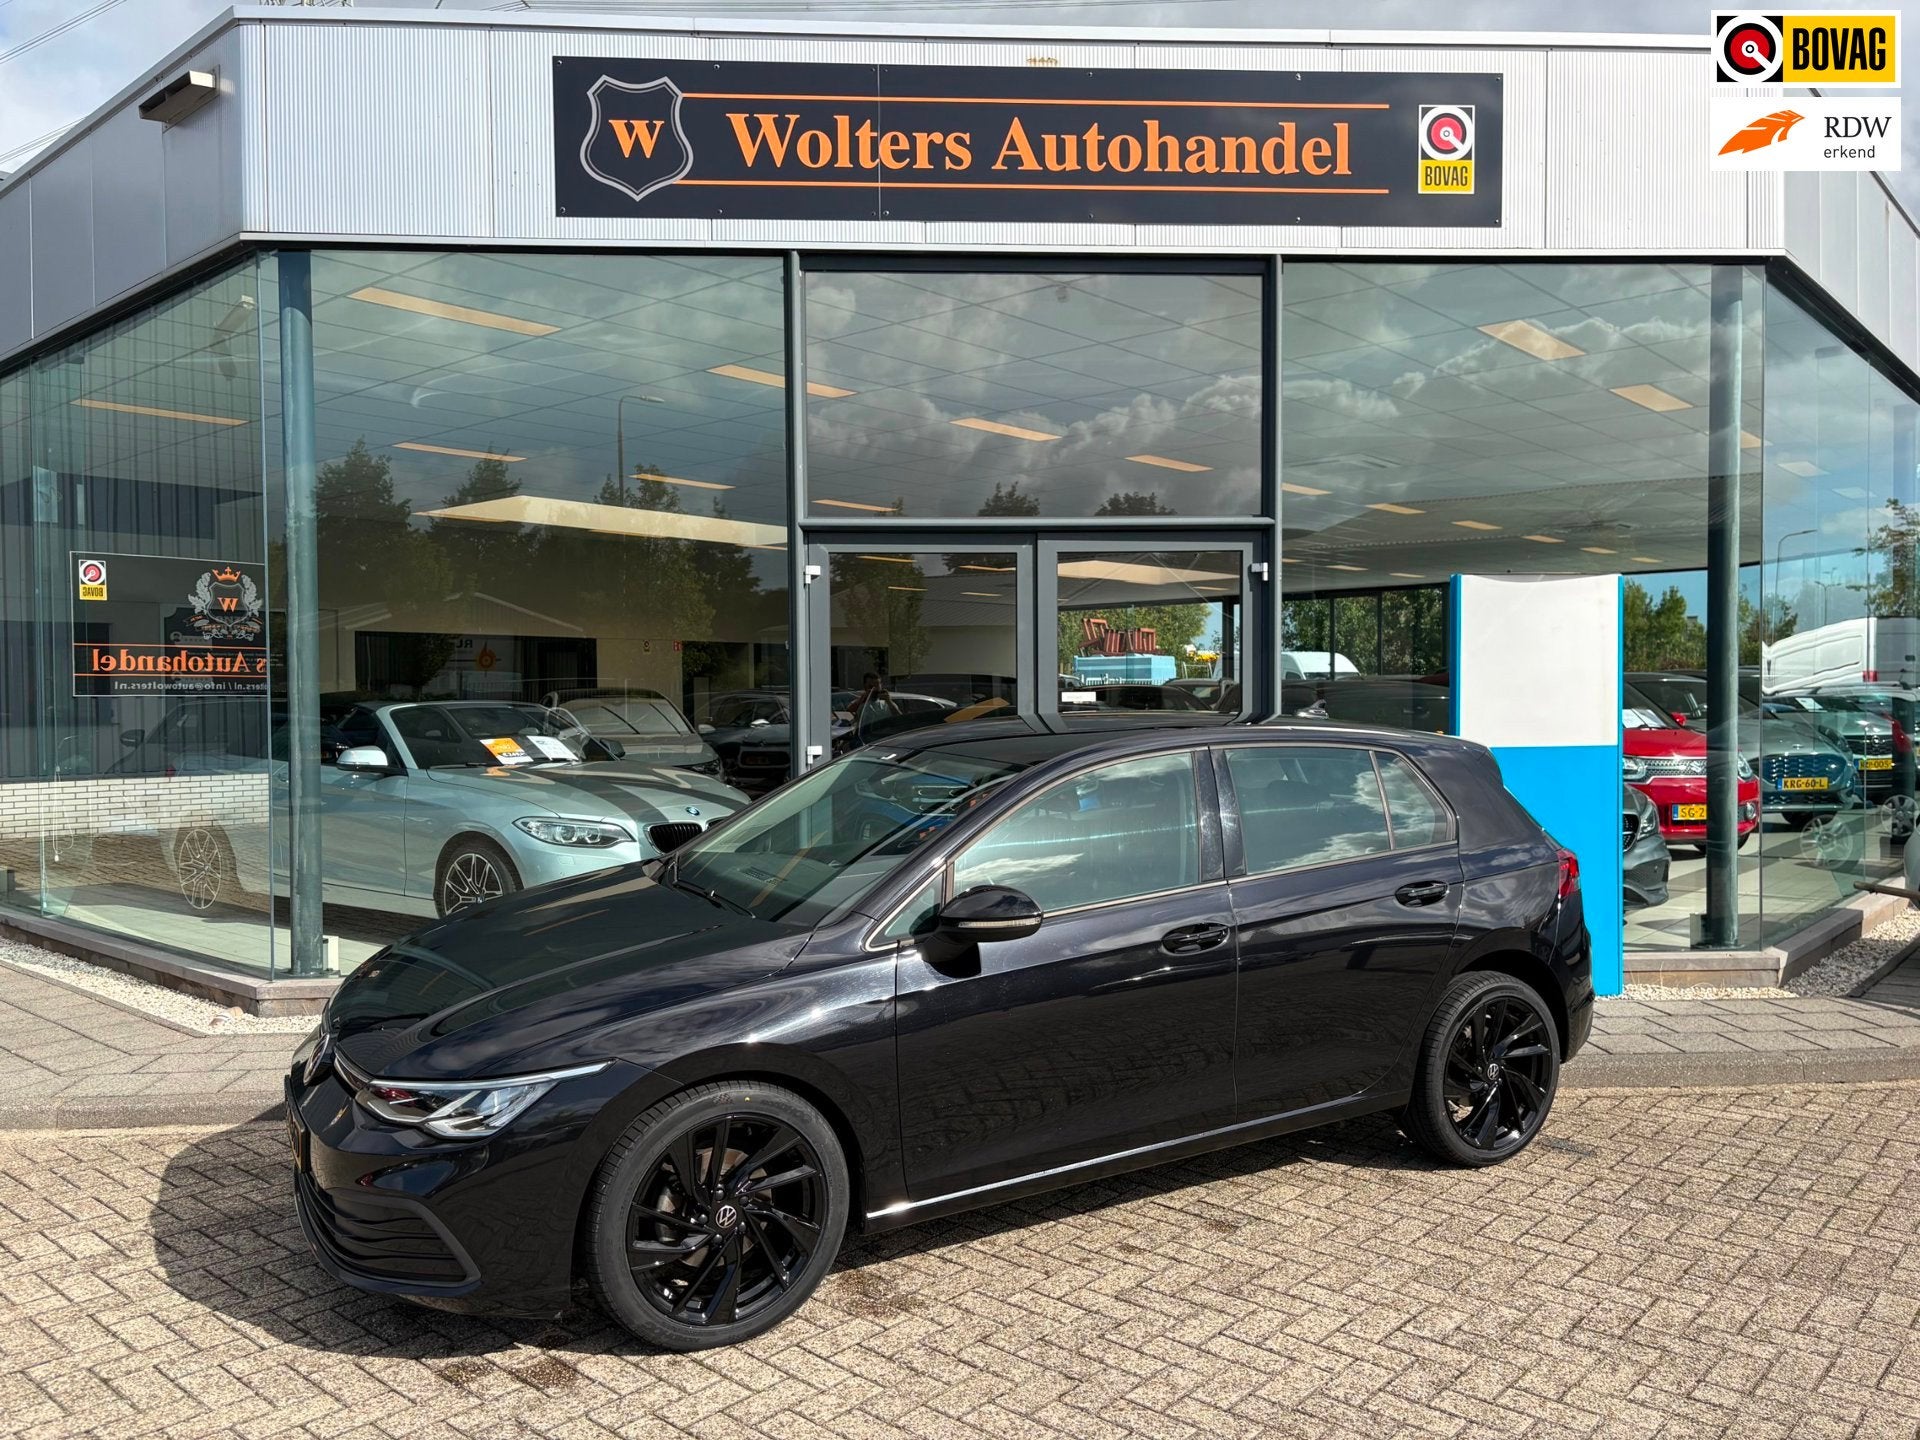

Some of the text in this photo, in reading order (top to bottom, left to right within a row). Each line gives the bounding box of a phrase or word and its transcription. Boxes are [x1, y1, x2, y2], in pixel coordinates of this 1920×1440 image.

[609, 119, 665, 158] W
[726, 112, 1352, 176] Wolters Autohandel
[1425, 165, 1468, 187] BOVAG
[1783, 779, 1824, 789] KRG-60-L
[1681, 807, 1705, 818] SG-2
